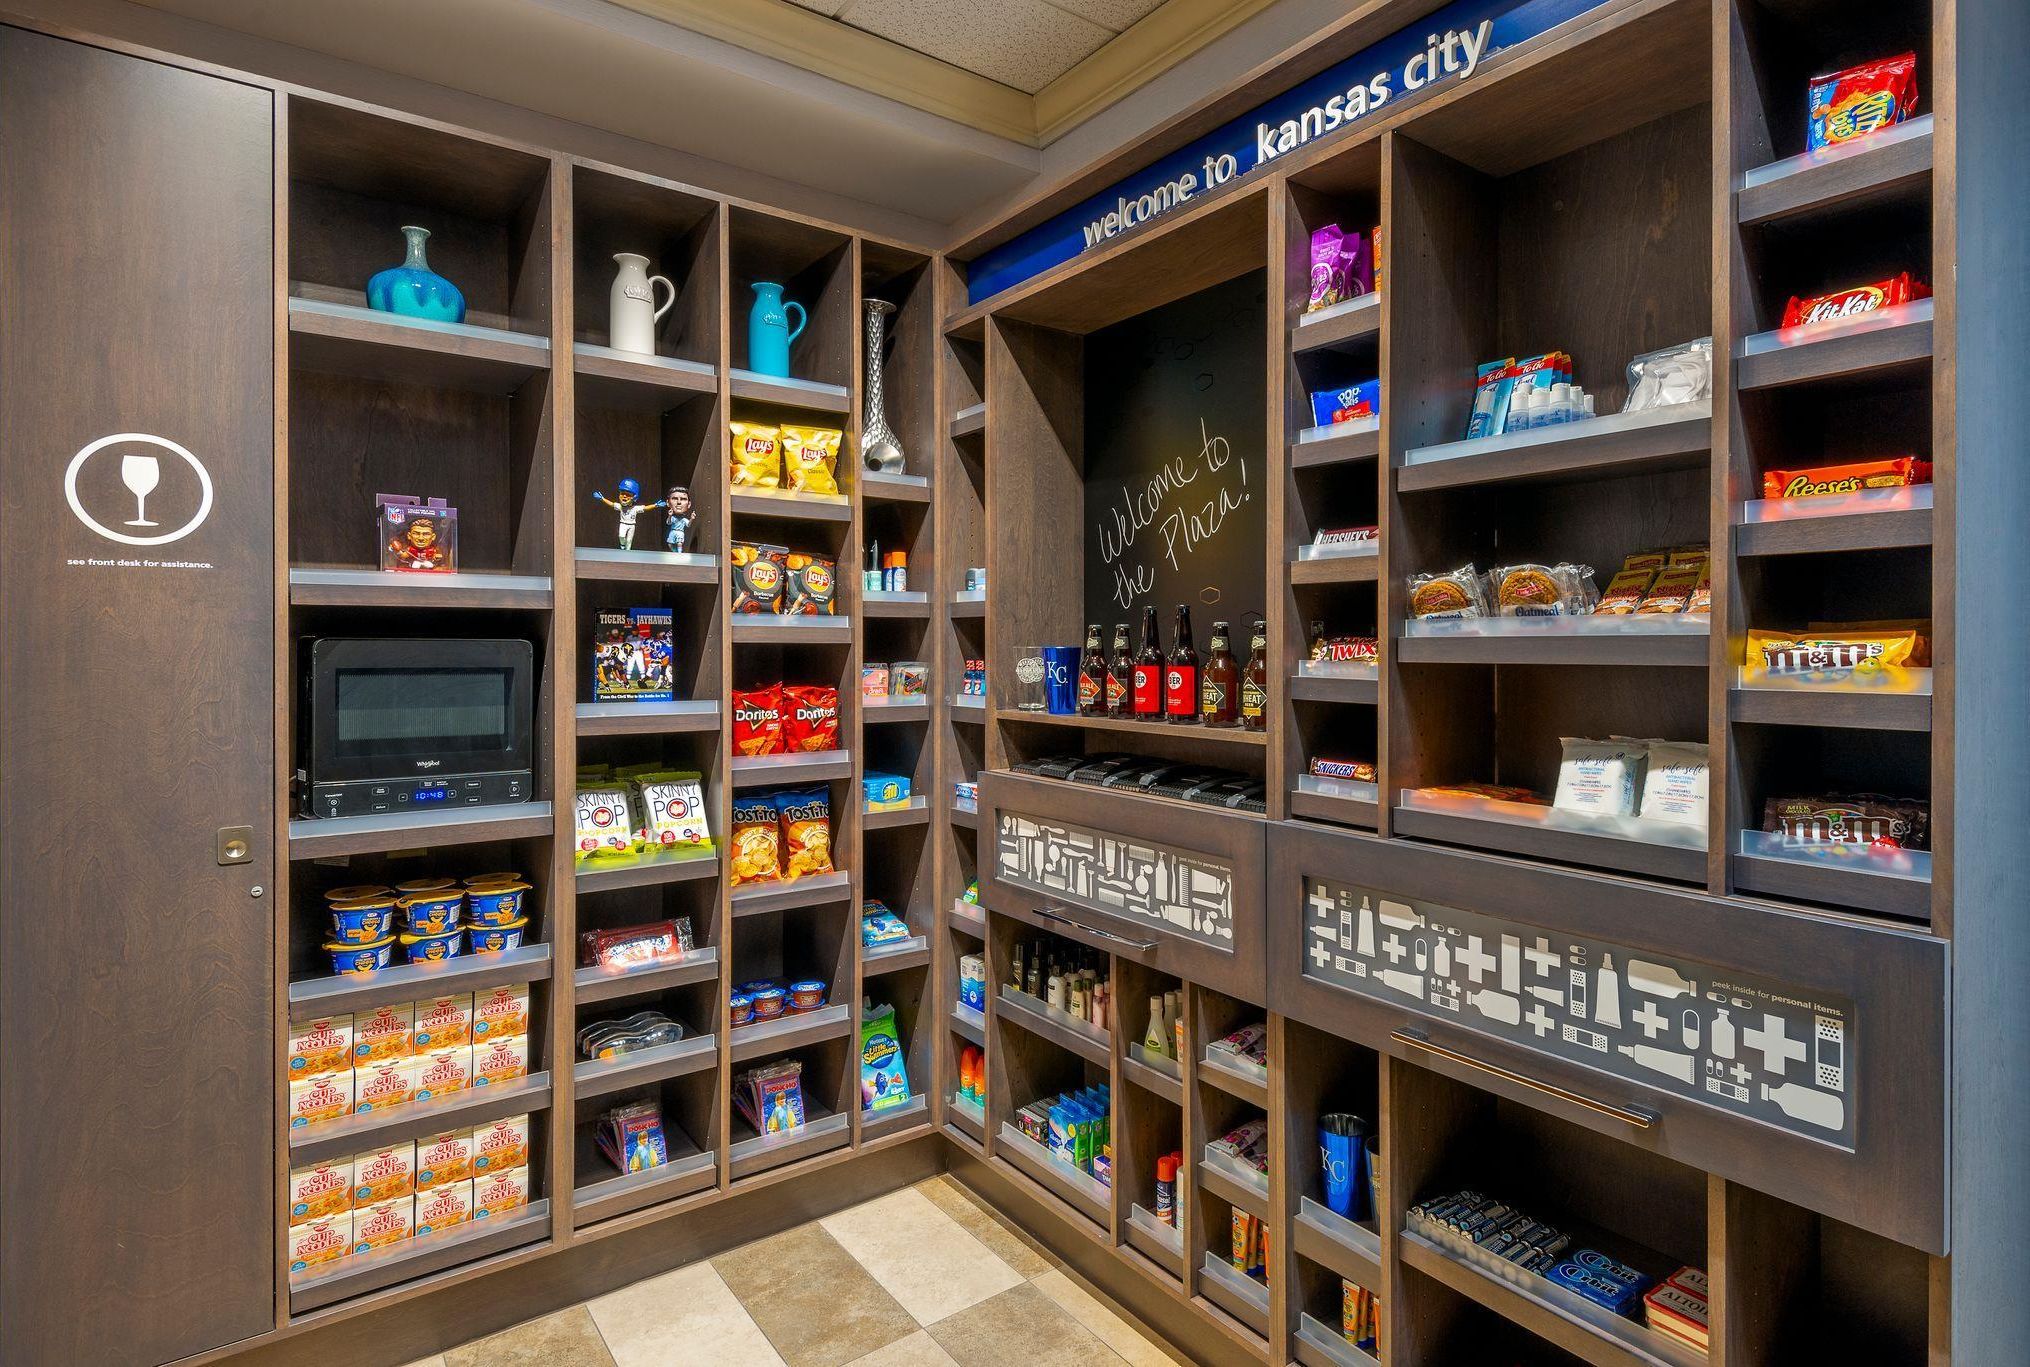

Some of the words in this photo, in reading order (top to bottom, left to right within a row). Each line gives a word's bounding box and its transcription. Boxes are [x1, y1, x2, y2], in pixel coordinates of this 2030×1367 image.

[1083, 172, 1198, 248] welcome
[1203, 153, 1239, 189] to
[1257, 71, 1392, 165] kansas
[1403, 19, 1494, 91] city
[1098, 456, 1199, 564] Welcome
[1198, 416, 1230, 473] to
[1784, 476, 1861, 499] Reese's
[1113, 563, 1155, 610] the
[1158, 457, 1251, 572] Plaza!
[1321, 529, 1370, 545] HERSHEY'S
[88, 559, 116, 567] front
[160, 561, 214, 569] assistance.
[1515, 604, 1560, 617] Oatmeal
[600, 614, 626, 625] TIGERS
[637, 615, 673, 625] JAYHAWKS
[1329, 642, 1376, 661] TWIX
[735, 709, 779, 721] Doritos
[797, 707, 836, 720] Doritos
[416, 759, 440, 769] Whirlpool
[1317, 760, 1356, 777] SNICKERS
[415, 791, 444, 800] 10:48
[652, 782, 696, 800] SKINNY
[883, 785, 898, 800] all
[577, 791, 621, 808] SKINNY
[578, 804, 625, 829] POP
[653, 796, 700, 821] POP
[491, 996, 514, 1006] CUP
[1712, 980, 1731, 990] peek
[1732, 984, 1756, 997] inside
[1757, 990, 1771, 999] for
[1771, 994, 1812, 1009] personal
[1814, 1003, 1844, 1017] items.
[432, 1006, 457, 1018] CUP
[480, 1001, 521, 1016] NOODLES
[372, 1016, 398, 1028] CUP
[422, 1012, 464, 1028] NOODLES
[308, 1029, 335, 1040] CUP
[361, 1021, 406, 1038] NOODLES
[296, 1035, 345, 1051] NOODLES
[480, 1056, 521, 1072] NOODLES
[489, 1051, 513, 1062] CUP
[432, 1062, 456, 1074] CUP
[374, 1074, 399, 1087] CUP
[422, 1068, 465, 1085] NOODLES
[309, 1087, 336, 1099] CUP
[363, 1079, 408, 1098] NOODLES
[298, 1093, 345, 1111] NOODLES
[490, 1129, 513, 1140] CUP
[435, 1141, 459, 1154] CUP
[480, 1134, 521, 1152] NOODLES
[373, 1157, 398, 1169] CUP
[425, 1147, 466, 1166] NOODLES
[1320, 1145, 1345, 1183] KC
[309, 1172, 336, 1185] CUP
[362, 1162, 407, 1182] NOODLES
[298, 1177, 346, 1198] NOODLES
[480, 1186, 521, 1204] NOODLES
[490, 1181, 514, 1193] CUP
[433, 1196, 457, 1208] CUP
[423, 1201, 465, 1220] NOODLES
[371, 1213, 397, 1225] CUP
[361, 1217, 406, 1238] NOODLES
[308, 1230, 335, 1243] CUP
[297, 1235, 344, 1256] NOODLES
